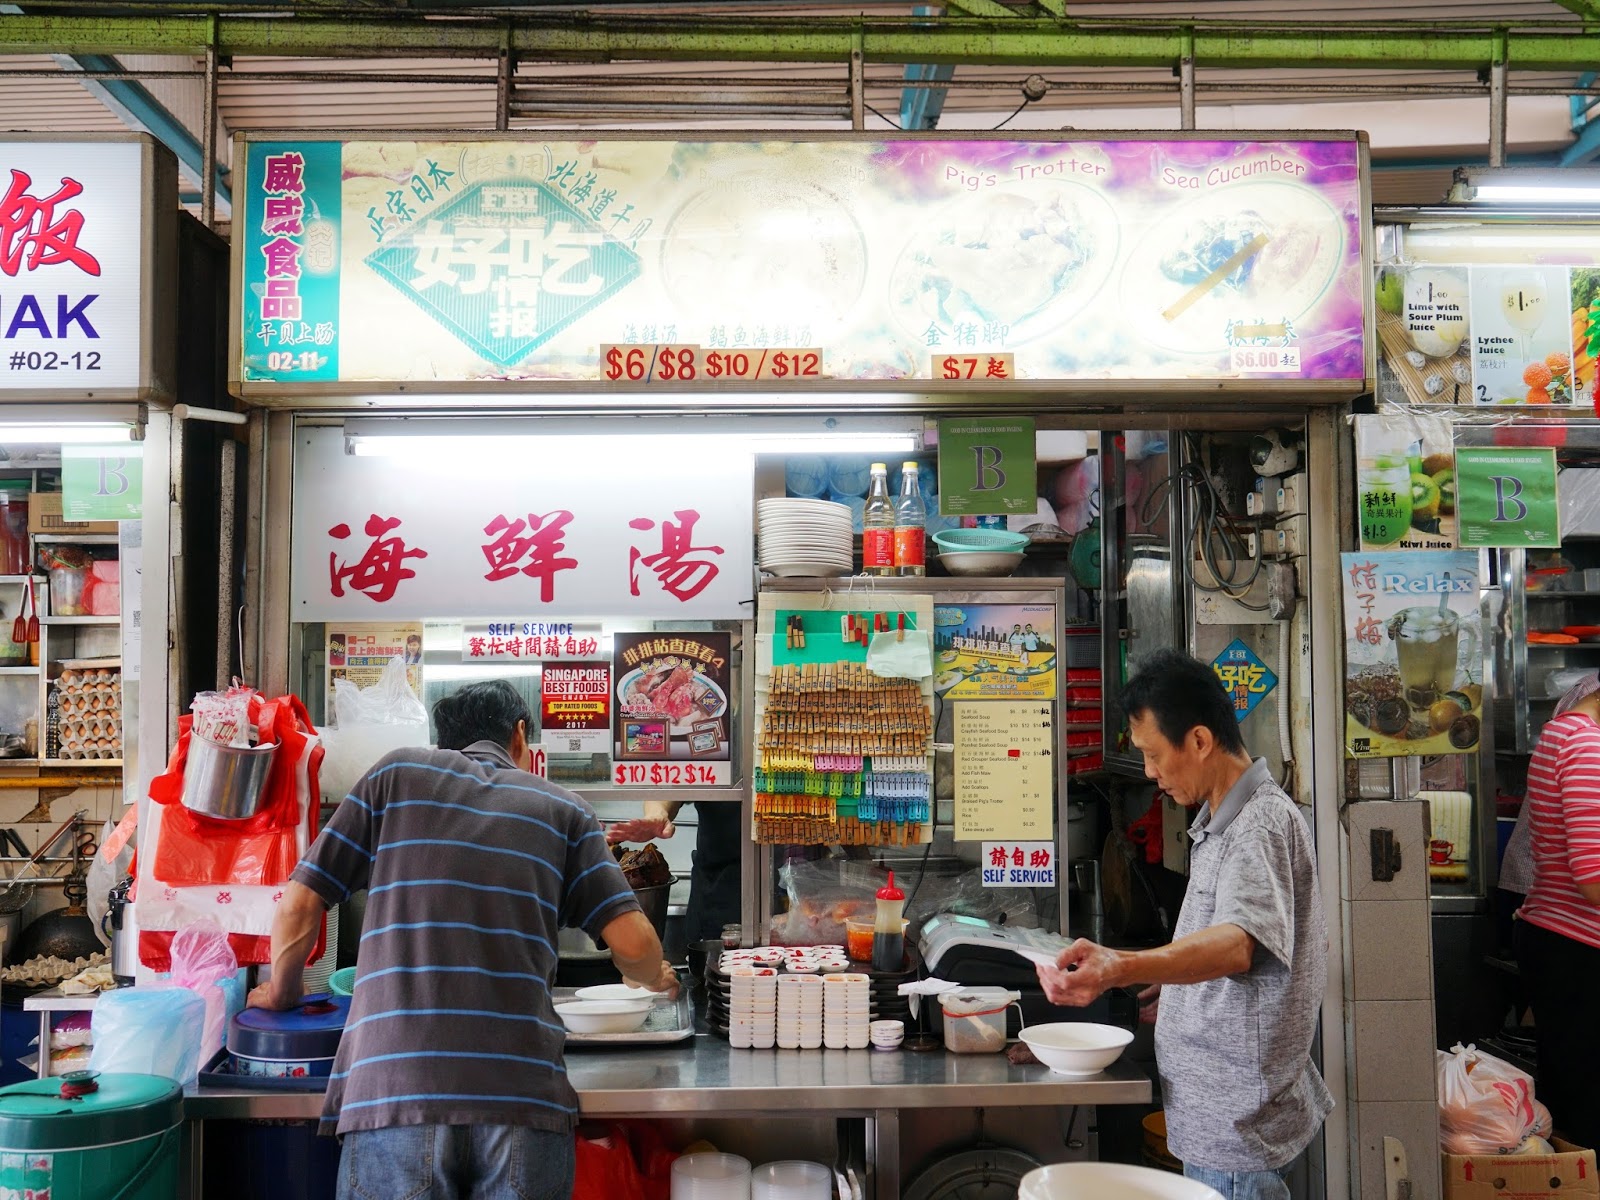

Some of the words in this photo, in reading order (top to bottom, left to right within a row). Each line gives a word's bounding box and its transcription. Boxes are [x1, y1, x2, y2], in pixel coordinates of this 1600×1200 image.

[945, 165, 997, 192] Pig's
[1013, 158, 1106, 182] Trotter
[1162, 167, 1200, 190] Sea
[1206, 153, 1306, 188] Cucumber
[367, 158, 455, 243] 正宗日本
[409, 221, 606, 296] 好吃
[0, 295, 100, 338] AK
[1408, 303, 1434, 311] Lime
[1436, 303, 1459, 311] with
[1408, 313, 1433, 321] Sour
[1436, 313, 1463, 321] Plum
[257, 321, 336, 346] 干贝上汤
[1409, 323, 1436, 331] Juice
[1478, 336, 1514, 345] Lychee
[1478, 346, 1505, 354] Juice
[10, 351, 101, 370] #02-12
[268, 351, 319, 371] 02-11
[942, 356, 978, 380] $7
[986, 357, 1008, 379] 起
[1235, 351, 1278, 369] $6.00
[1477, 384, 1493, 402] 2
[92, 456, 130, 497] B
[968, 445, 1007, 492] B
[1488, 475, 1528, 523] B
[1400, 540, 1423, 549] Kiwi
[1425, 540, 1453, 549] Juice
[1383, 573, 1474, 594] Relax
[1349, 560, 1383, 646] 桔子梅
[488, 623, 516, 636] SELF
[523, 623, 573, 636] SERVICE
[469, 636, 598, 657] 繁忙時間請自助
[1229, 649, 1246, 659] FBI
[544, 669, 608, 681] SINGAPORE
[545, 682, 570, 693] BEST
[573, 682, 606, 693] FOODS
[615, 763, 646, 785] $10
[650, 763, 681, 785] $12
[685, 763, 716, 785] $14
[989, 845, 1050, 869] 請自助
[983, 869, 1005, 883] SELF
[1010, 869, 1054, 883] SERVICE
